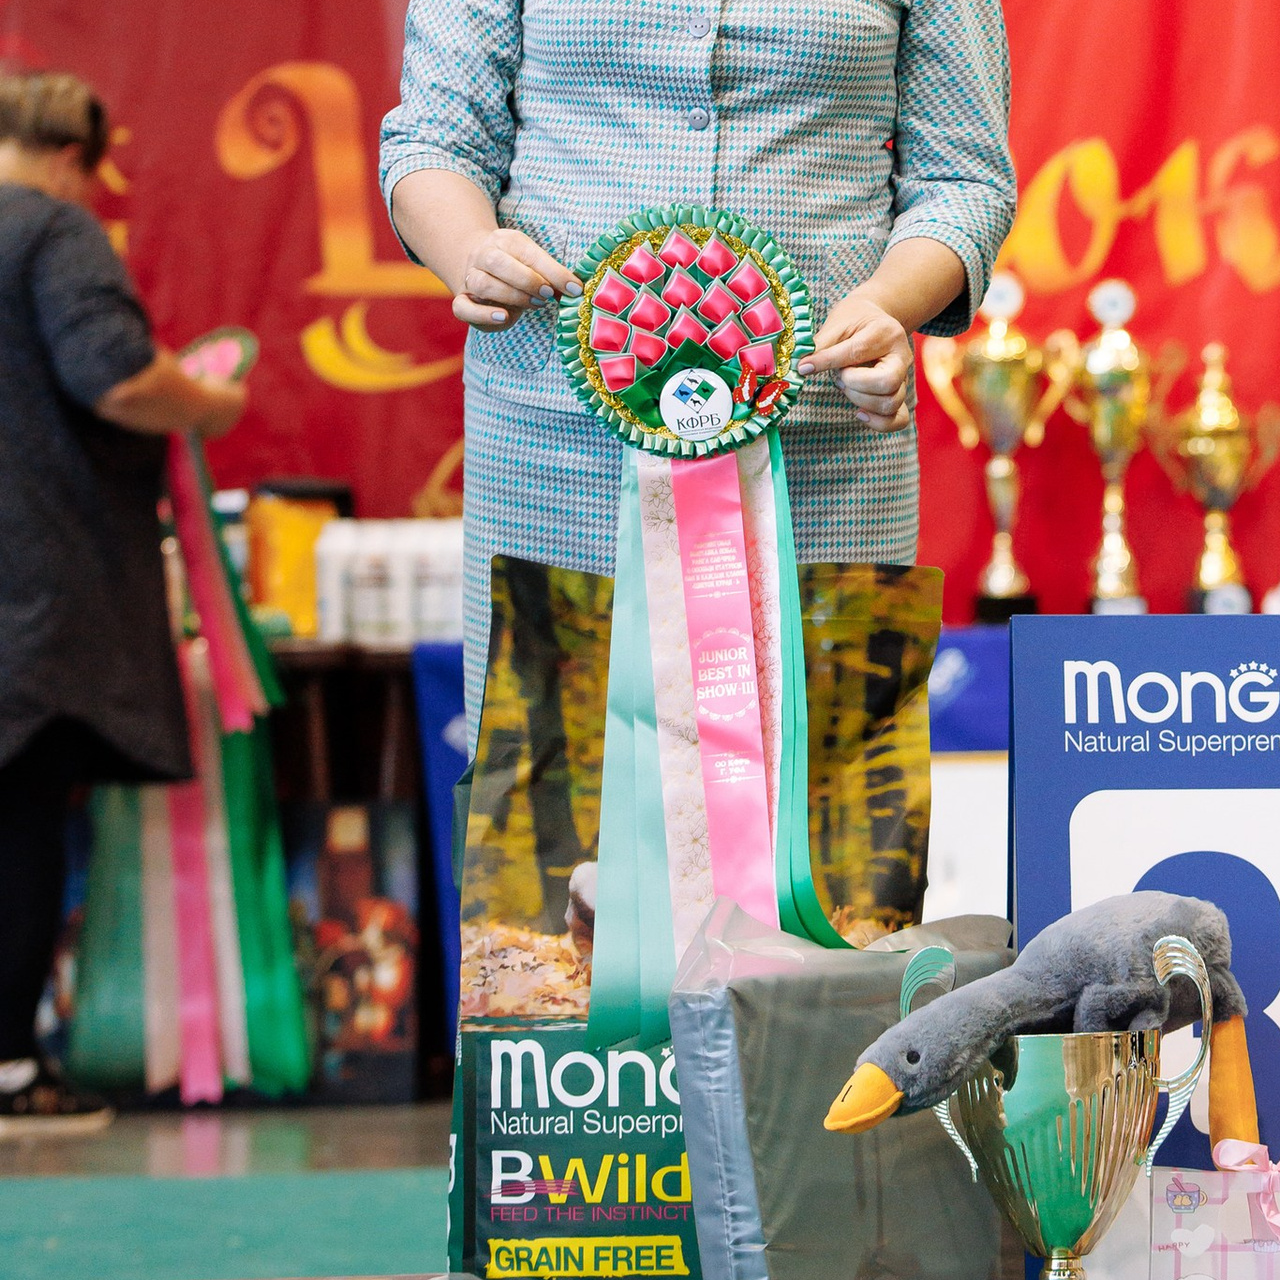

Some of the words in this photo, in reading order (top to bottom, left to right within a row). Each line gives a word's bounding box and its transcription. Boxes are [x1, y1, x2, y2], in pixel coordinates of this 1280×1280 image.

[676, 413, 721, 430] КФРБ
[698, 646, 748, 664] JUNIOR
[698, 665, 733, 682] BEST
[737, 663, 751, 679] IN
[1065, 730, 1150, 753] Natural
[490, 1110, 574, 1136] Natural
[490, 1149, 693, 1204] BWild
[490, 1206, 538, 1222] FEED
[544, 1206, 584, 1222] THE
[592, 1205, 692, 1222] INSTINCT
[1157, 1241, 1191, 1252] HAPPY
[494, 1246, 584, 1272] GRAIN
[593, 1244, 675, 1271] FREE
